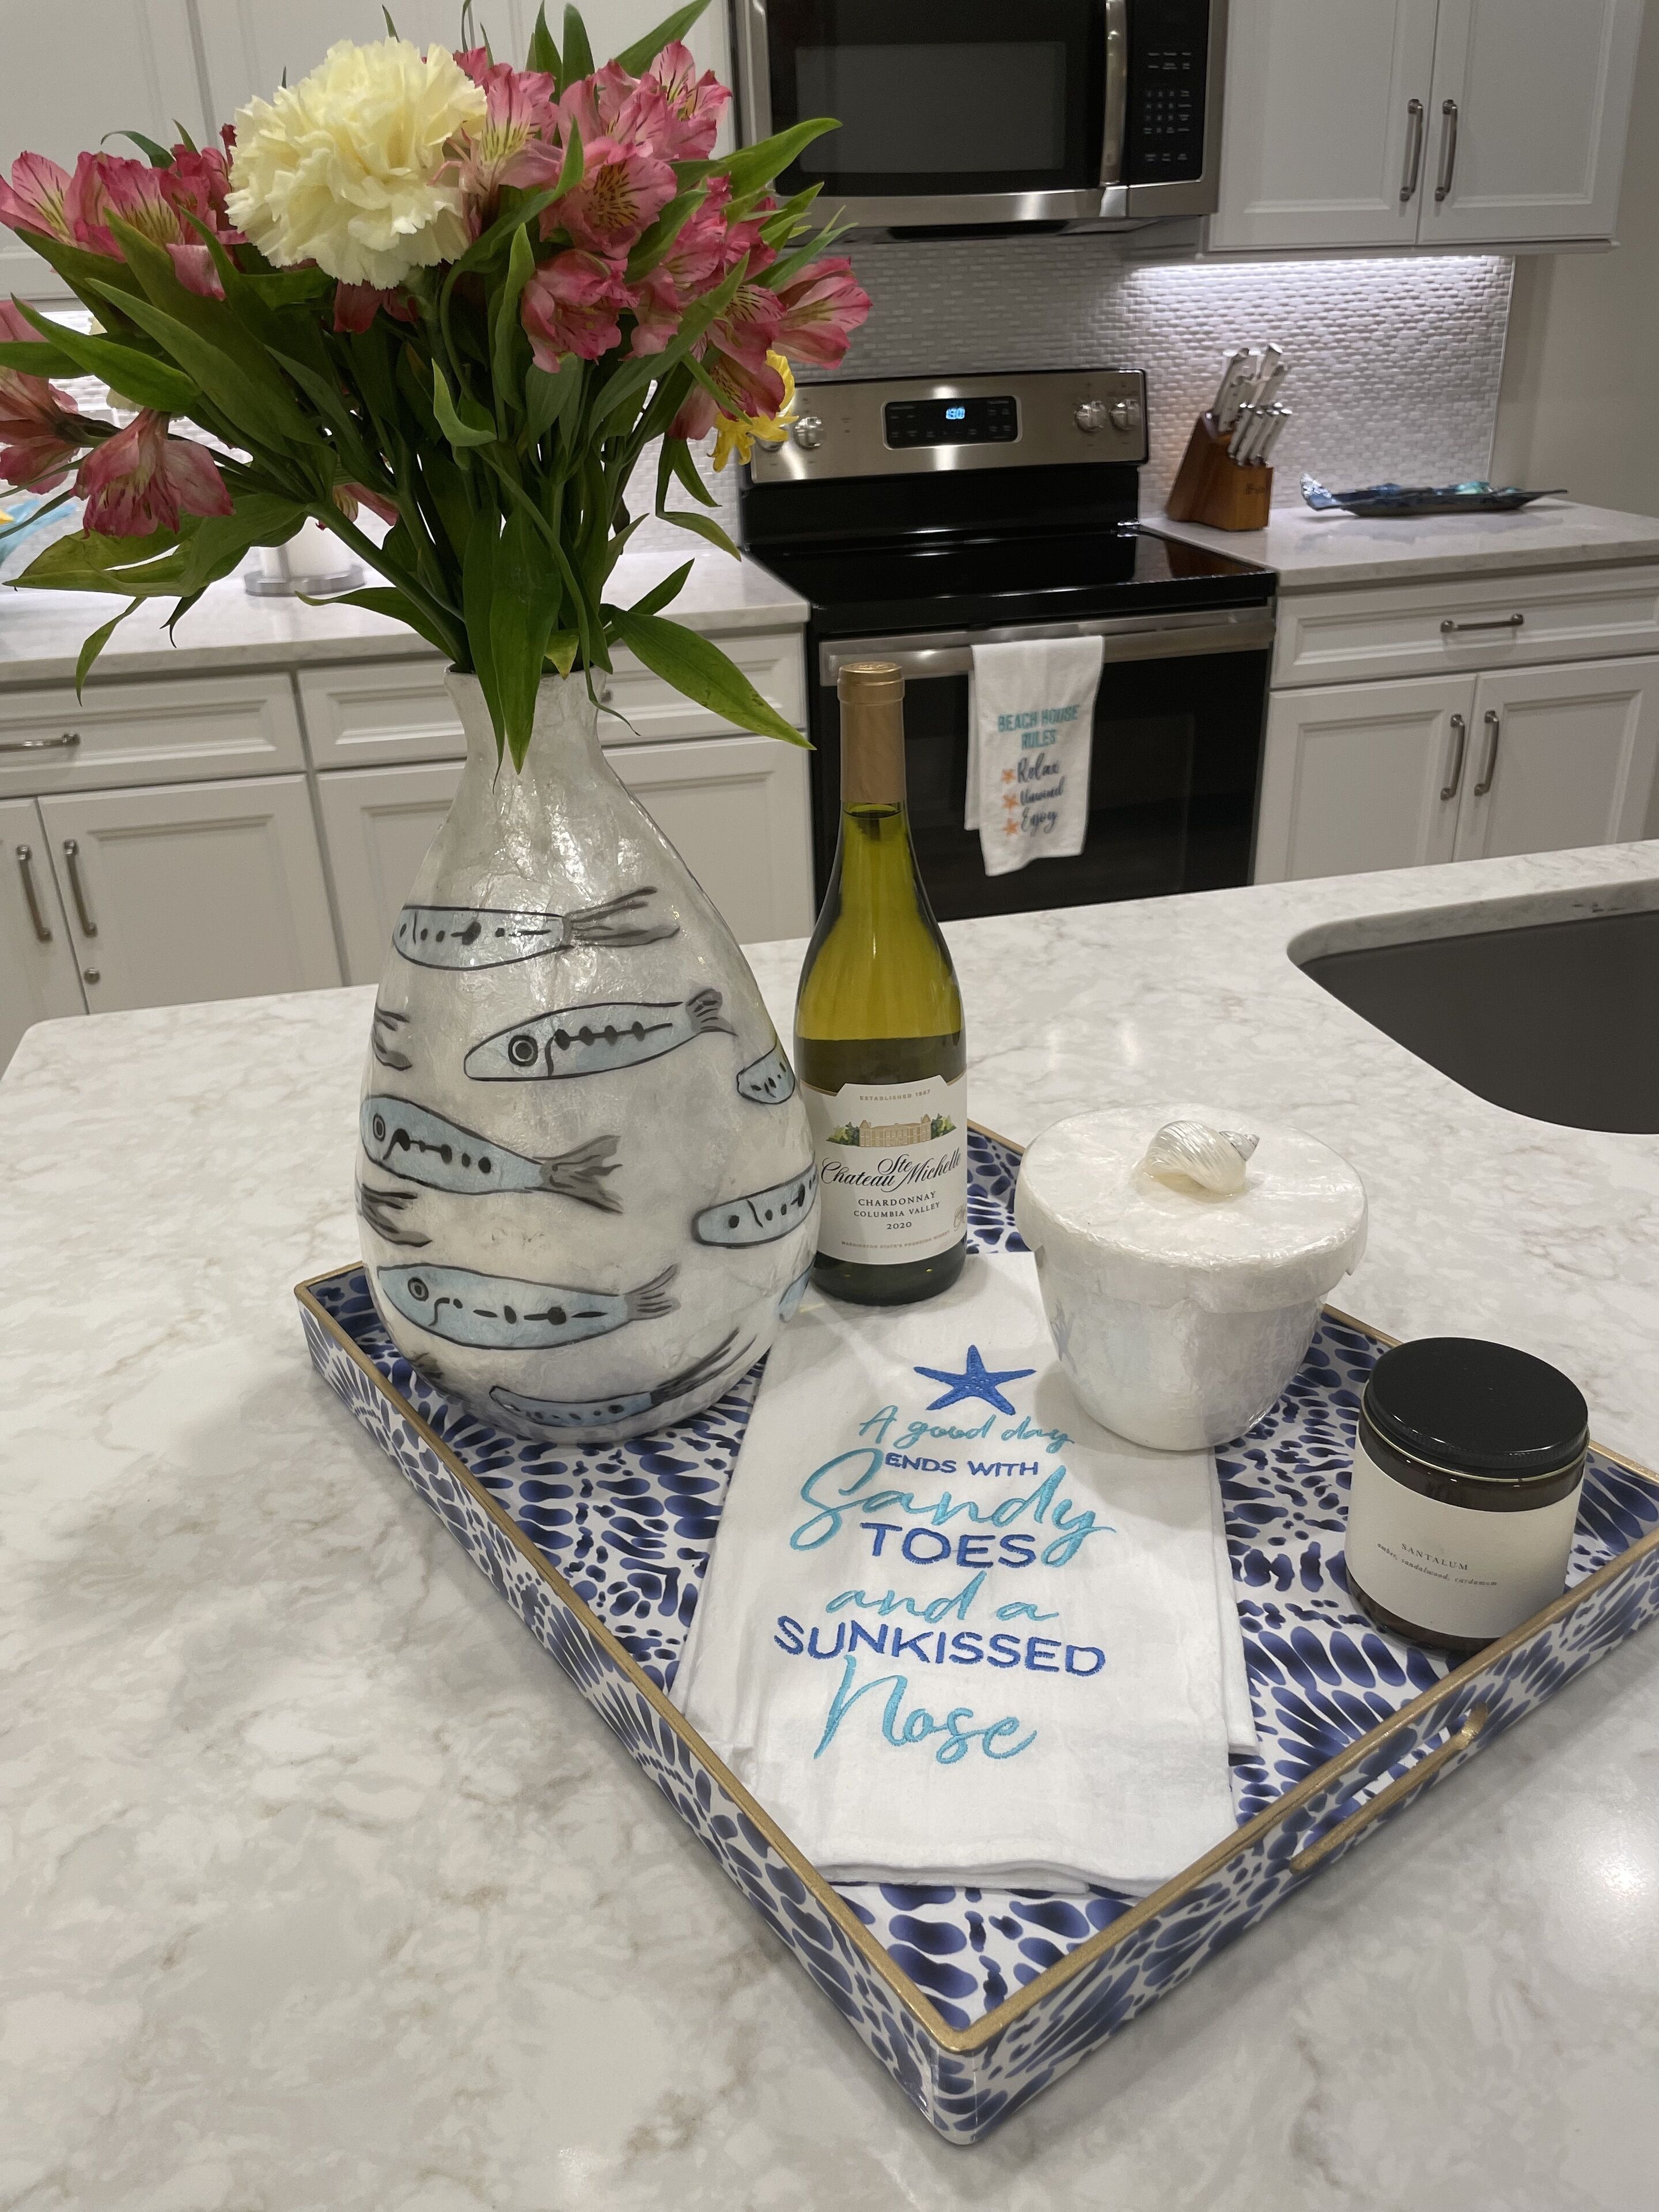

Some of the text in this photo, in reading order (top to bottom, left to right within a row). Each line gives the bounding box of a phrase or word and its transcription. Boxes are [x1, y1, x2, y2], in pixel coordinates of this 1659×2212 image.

[998, 711, 1038, 733] BEACH
[821, 1157, 895, 1187] Chateau
[877, 1153, 912, 1175] Ste
[858, 1191, 936, 1207] CHARDONNAY
[908, 1201, 941, 1215] VALLEY
[887, 1221, 912, 1230] 2020
[859, 1405, 1075, 1454] A good day
[885, 1452, 1039, 1476] ENDS WITH
[790, 1447, 1116, 1567] Sandy
[860, 1522, 1037, 1569] TOES
[1401, 1543, 1468, 1571] SANTALUM
[826, 1570, 1060, 1623] and a
[774, 1615, 1106, 1677] SUNKISSED
